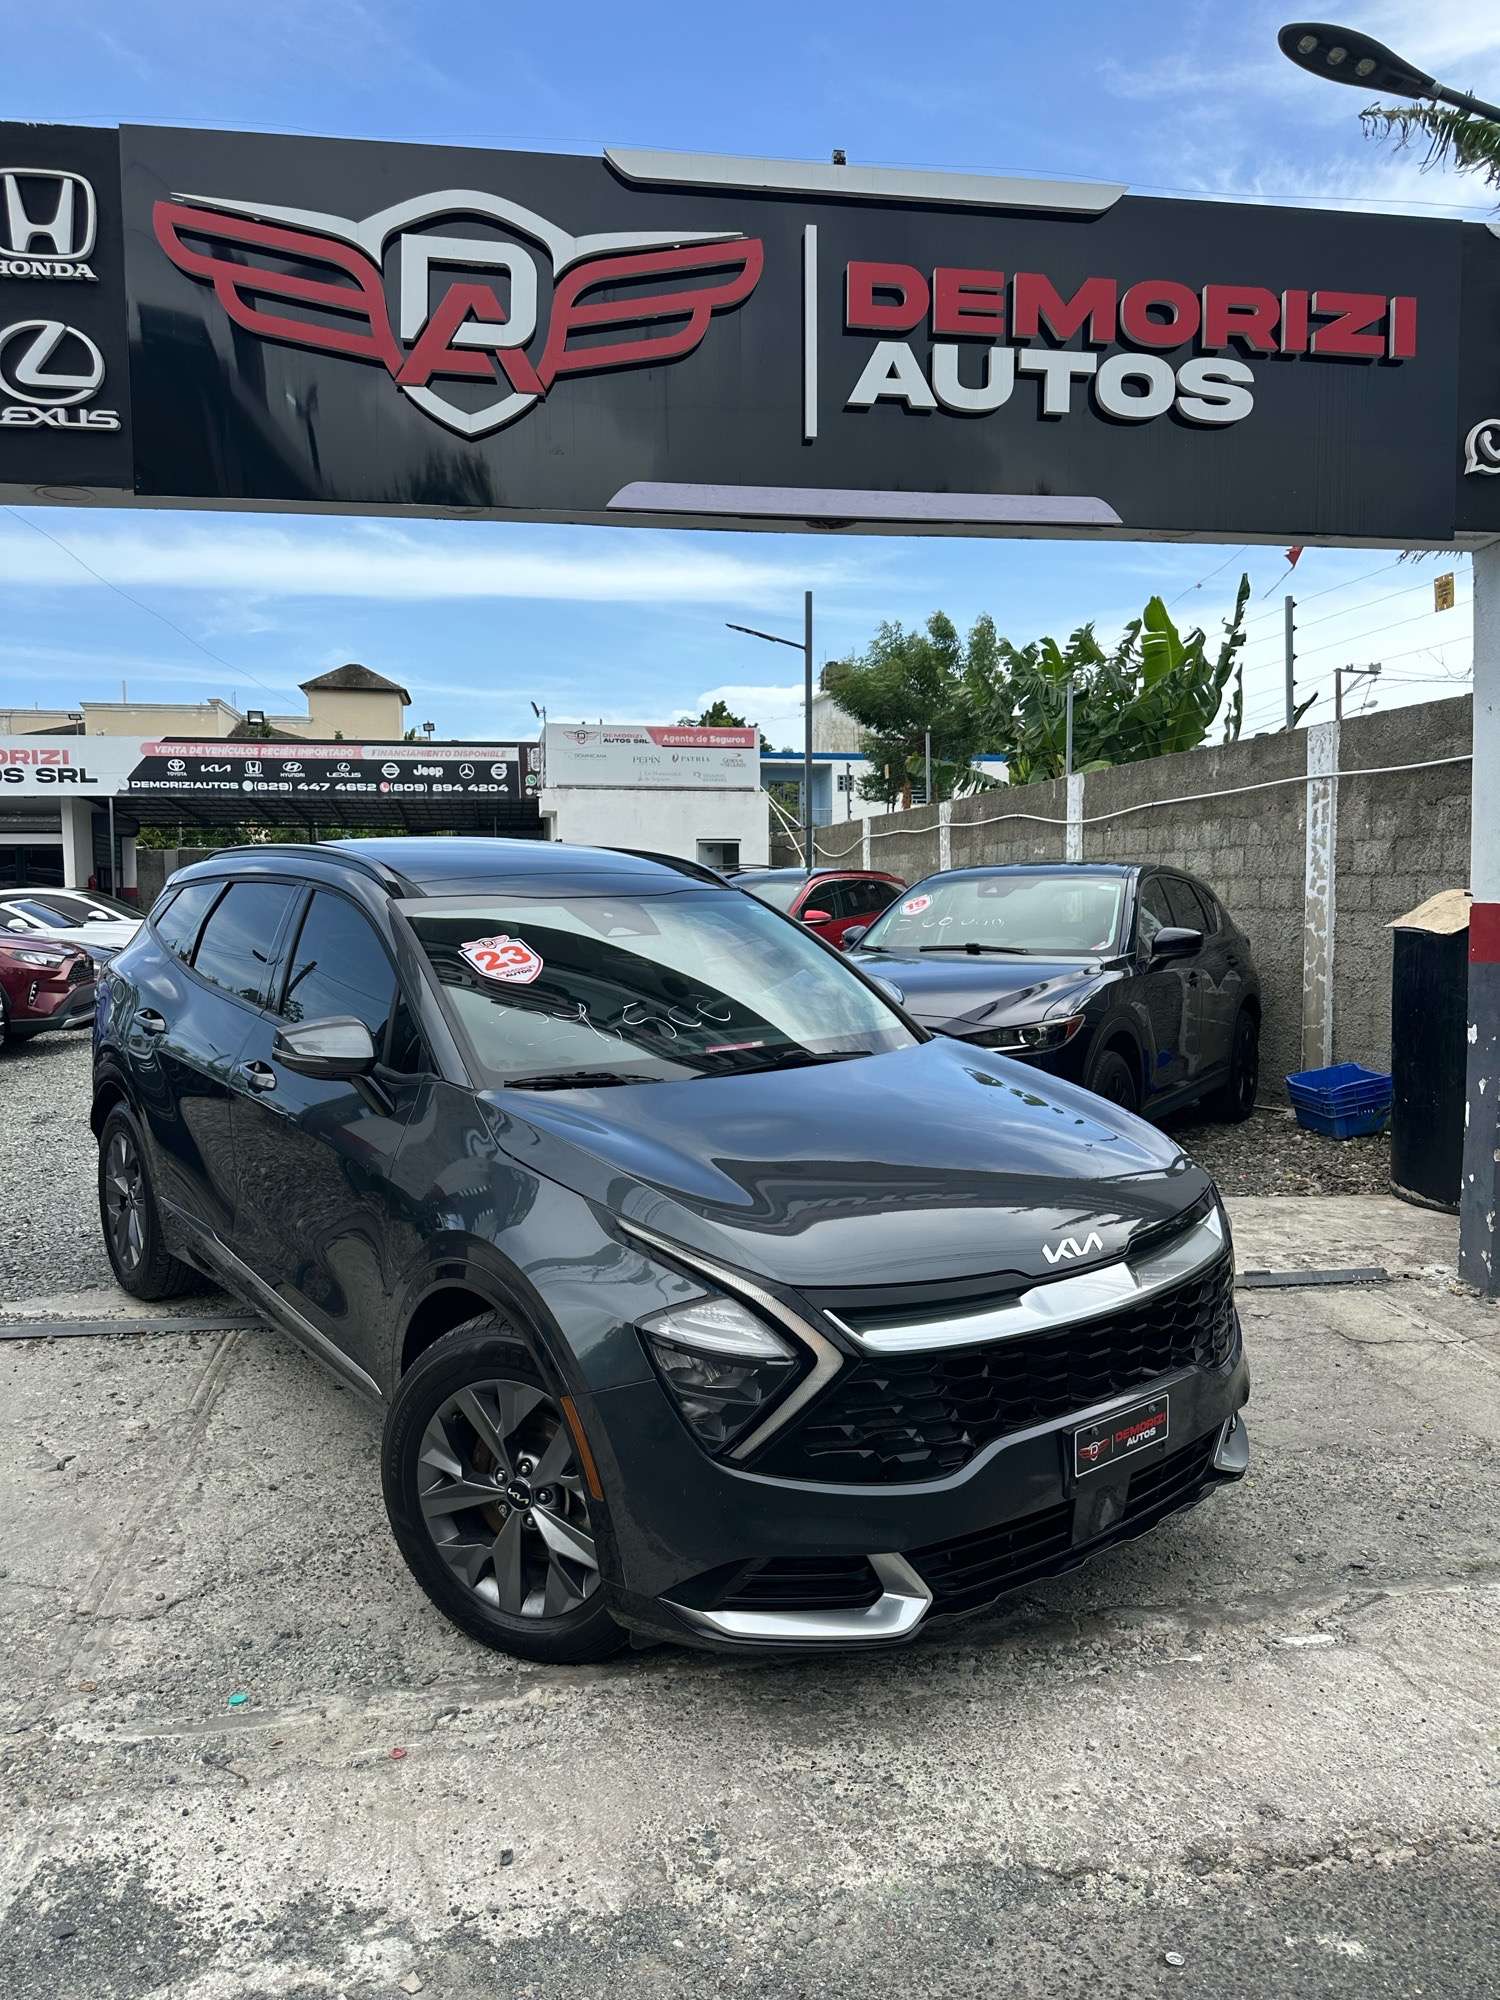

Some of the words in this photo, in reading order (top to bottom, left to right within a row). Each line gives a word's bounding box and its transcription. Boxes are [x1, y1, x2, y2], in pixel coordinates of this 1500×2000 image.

[844, 260, 1418, 360] DEMORIZI
[846, 340, 1256, 424] AUTOS
[0, 406, 121, 430] EXUS
[662, 734, 694, 745] Agente
[696, 735, 708, 743] de
[709, 735, 746, 744] Seguros
[154, 745, 187, 754] VENTA
[189, 746, 203, 754] DE
[205, 745, 259, 755] VEHÍCULOS
[298, 747, 354, 757] IMPORTADO
[371, 749, 452, 758] FINANCIAMIENTO
[453, 750, 506, 758] DISPONIBLE
[35, 767, 98, 783] SRL
[412, 764, 444, 778] Jeep
[131, 780, 239, 790] DEMORIZIAUTOS
[253, 781, 293, 792] (829)
[297, 782, 330, 791] 447
[334, 782, 377, 792] 4652
[390, 782, 428, 793] (809)
[432, 783, 464, 792] 894
[467, 783, 509, 792] 4204
[475, 945, 531, 971] 23
[1115, 1412, 1166, 1442] DEMORIZI
[1126, 1426, 1157, 1447] AUTOS
